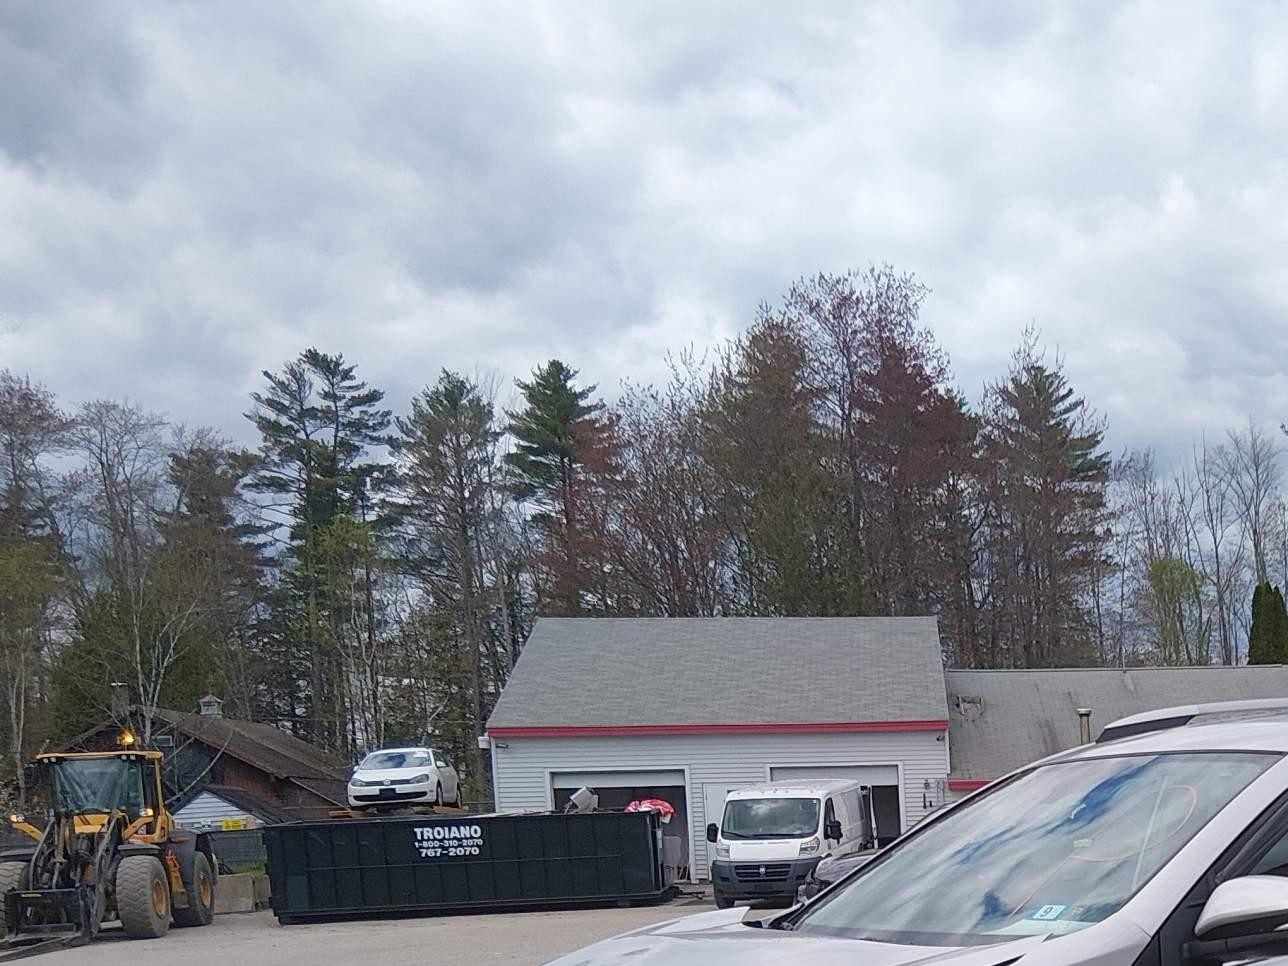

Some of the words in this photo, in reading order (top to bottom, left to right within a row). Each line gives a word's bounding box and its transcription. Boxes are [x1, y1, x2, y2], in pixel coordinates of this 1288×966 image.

[414, 825, 482, 840] TROIANO
[414, 839, 484, 848] 1-800-310-2070
[419, 847, 480, 857] 767-2070
